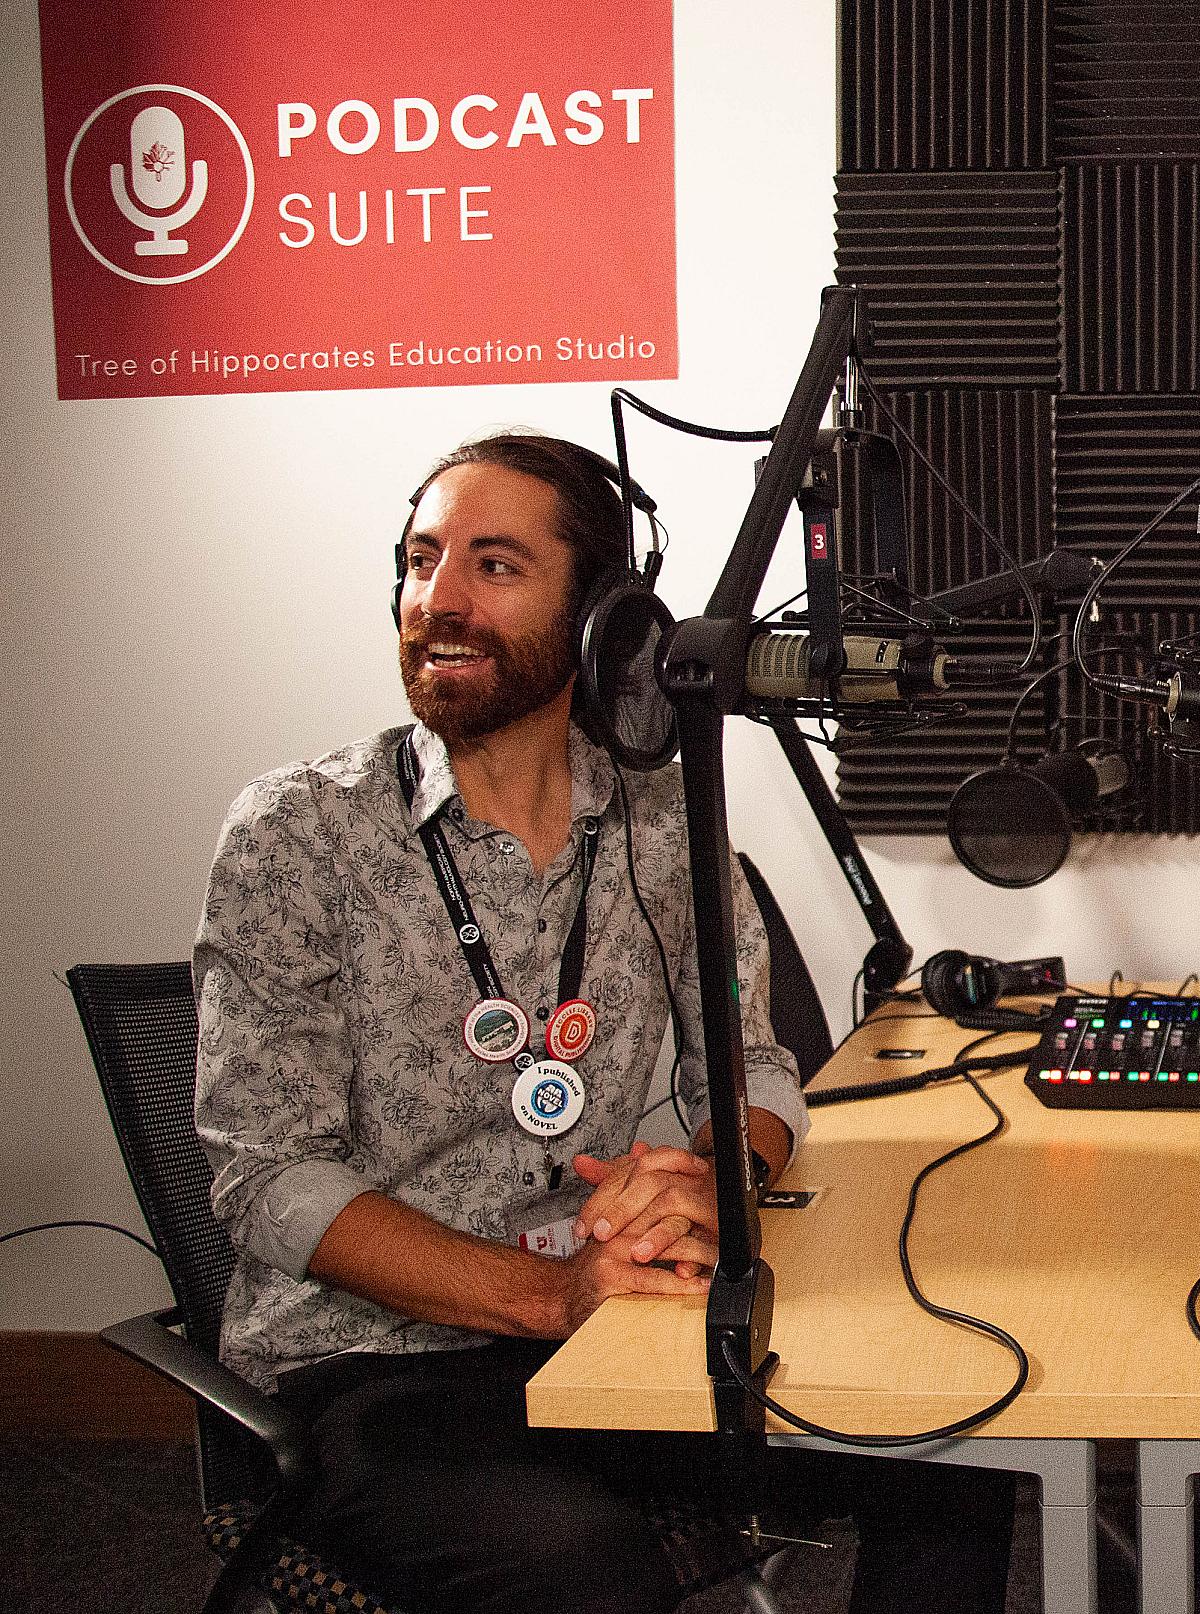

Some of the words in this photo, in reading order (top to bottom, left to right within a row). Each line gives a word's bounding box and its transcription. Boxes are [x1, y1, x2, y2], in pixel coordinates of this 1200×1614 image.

[277, 88, 654, 157] PODCAST
[278, 185, 494, 248] SUITE
[75, 354, 137, 377] Tree
[151, 350, 179, 375] of
[191, 346, 375, 378] Hippocrates
[389, 339, 543, 367] Education
[556, 334, 656, 361] Studio
[814, 534, 825, 550] 3
[435, 853, 449, 881] AMERICAN
[537, 1066, 542, 1074] I
[543, 1068, 581, 1097] published
[537, 1088, 563, 1108] NOVEL
[520, 1105, 529, 1117] on
[527, 1115, 558, 1130] NOVEL
